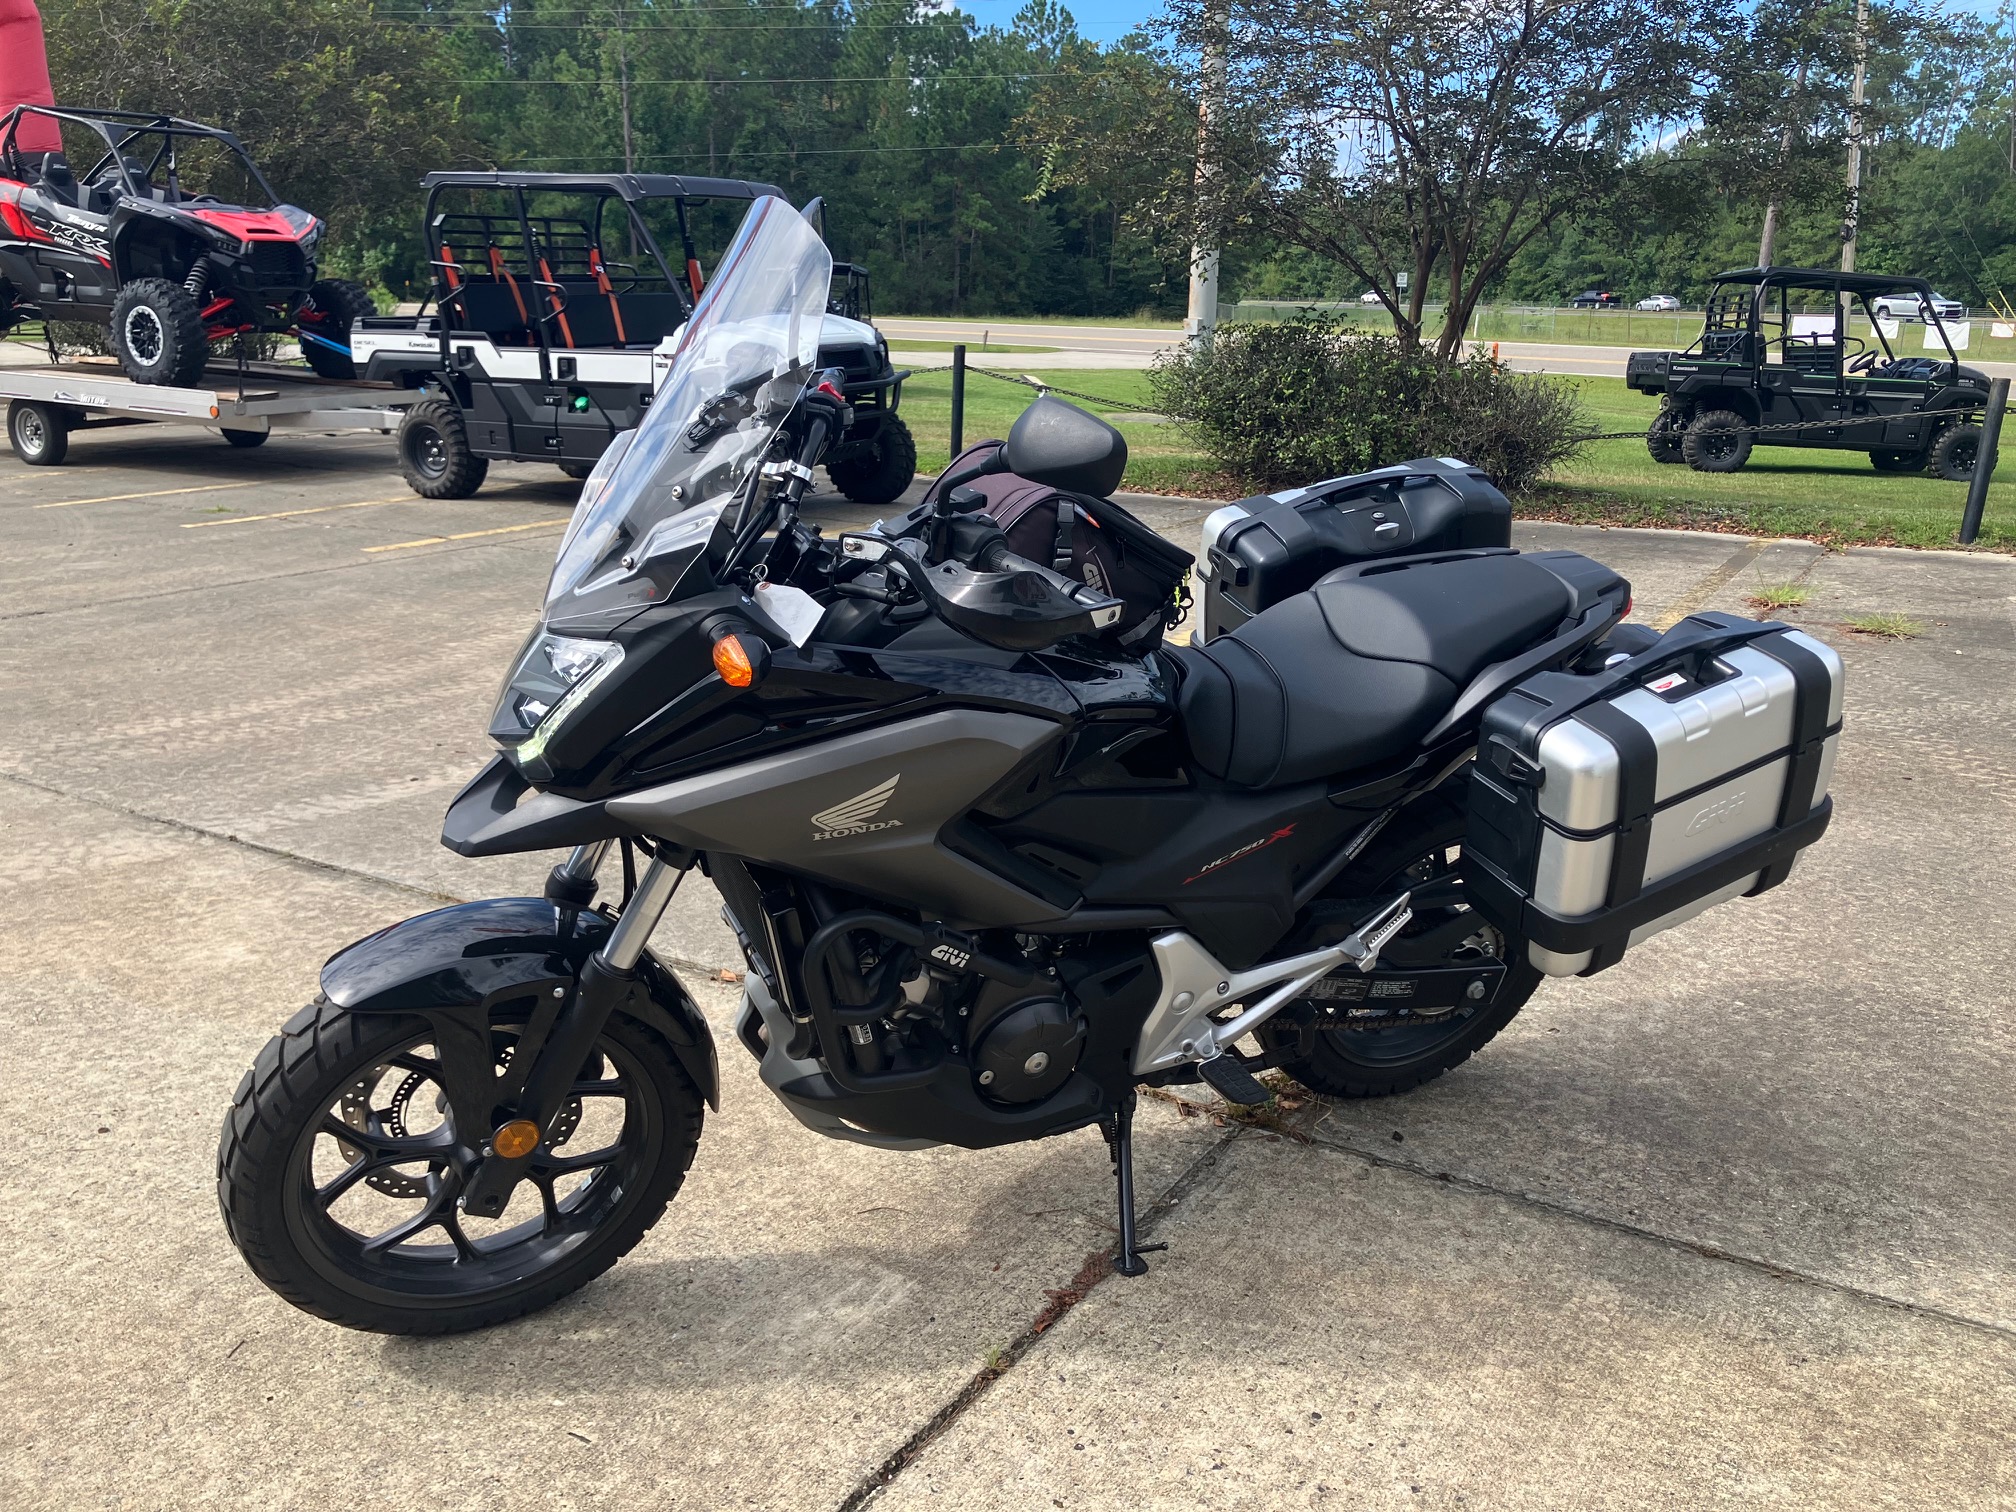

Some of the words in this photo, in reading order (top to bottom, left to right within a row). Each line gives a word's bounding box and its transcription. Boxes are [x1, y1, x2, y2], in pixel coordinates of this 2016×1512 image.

[49, 221, 111, 255] KRX
[408, 341, 436, 349] Kawasaki
[812, 819, 904, 841] HONDA
[930, 944, 971, 968] GIVI
